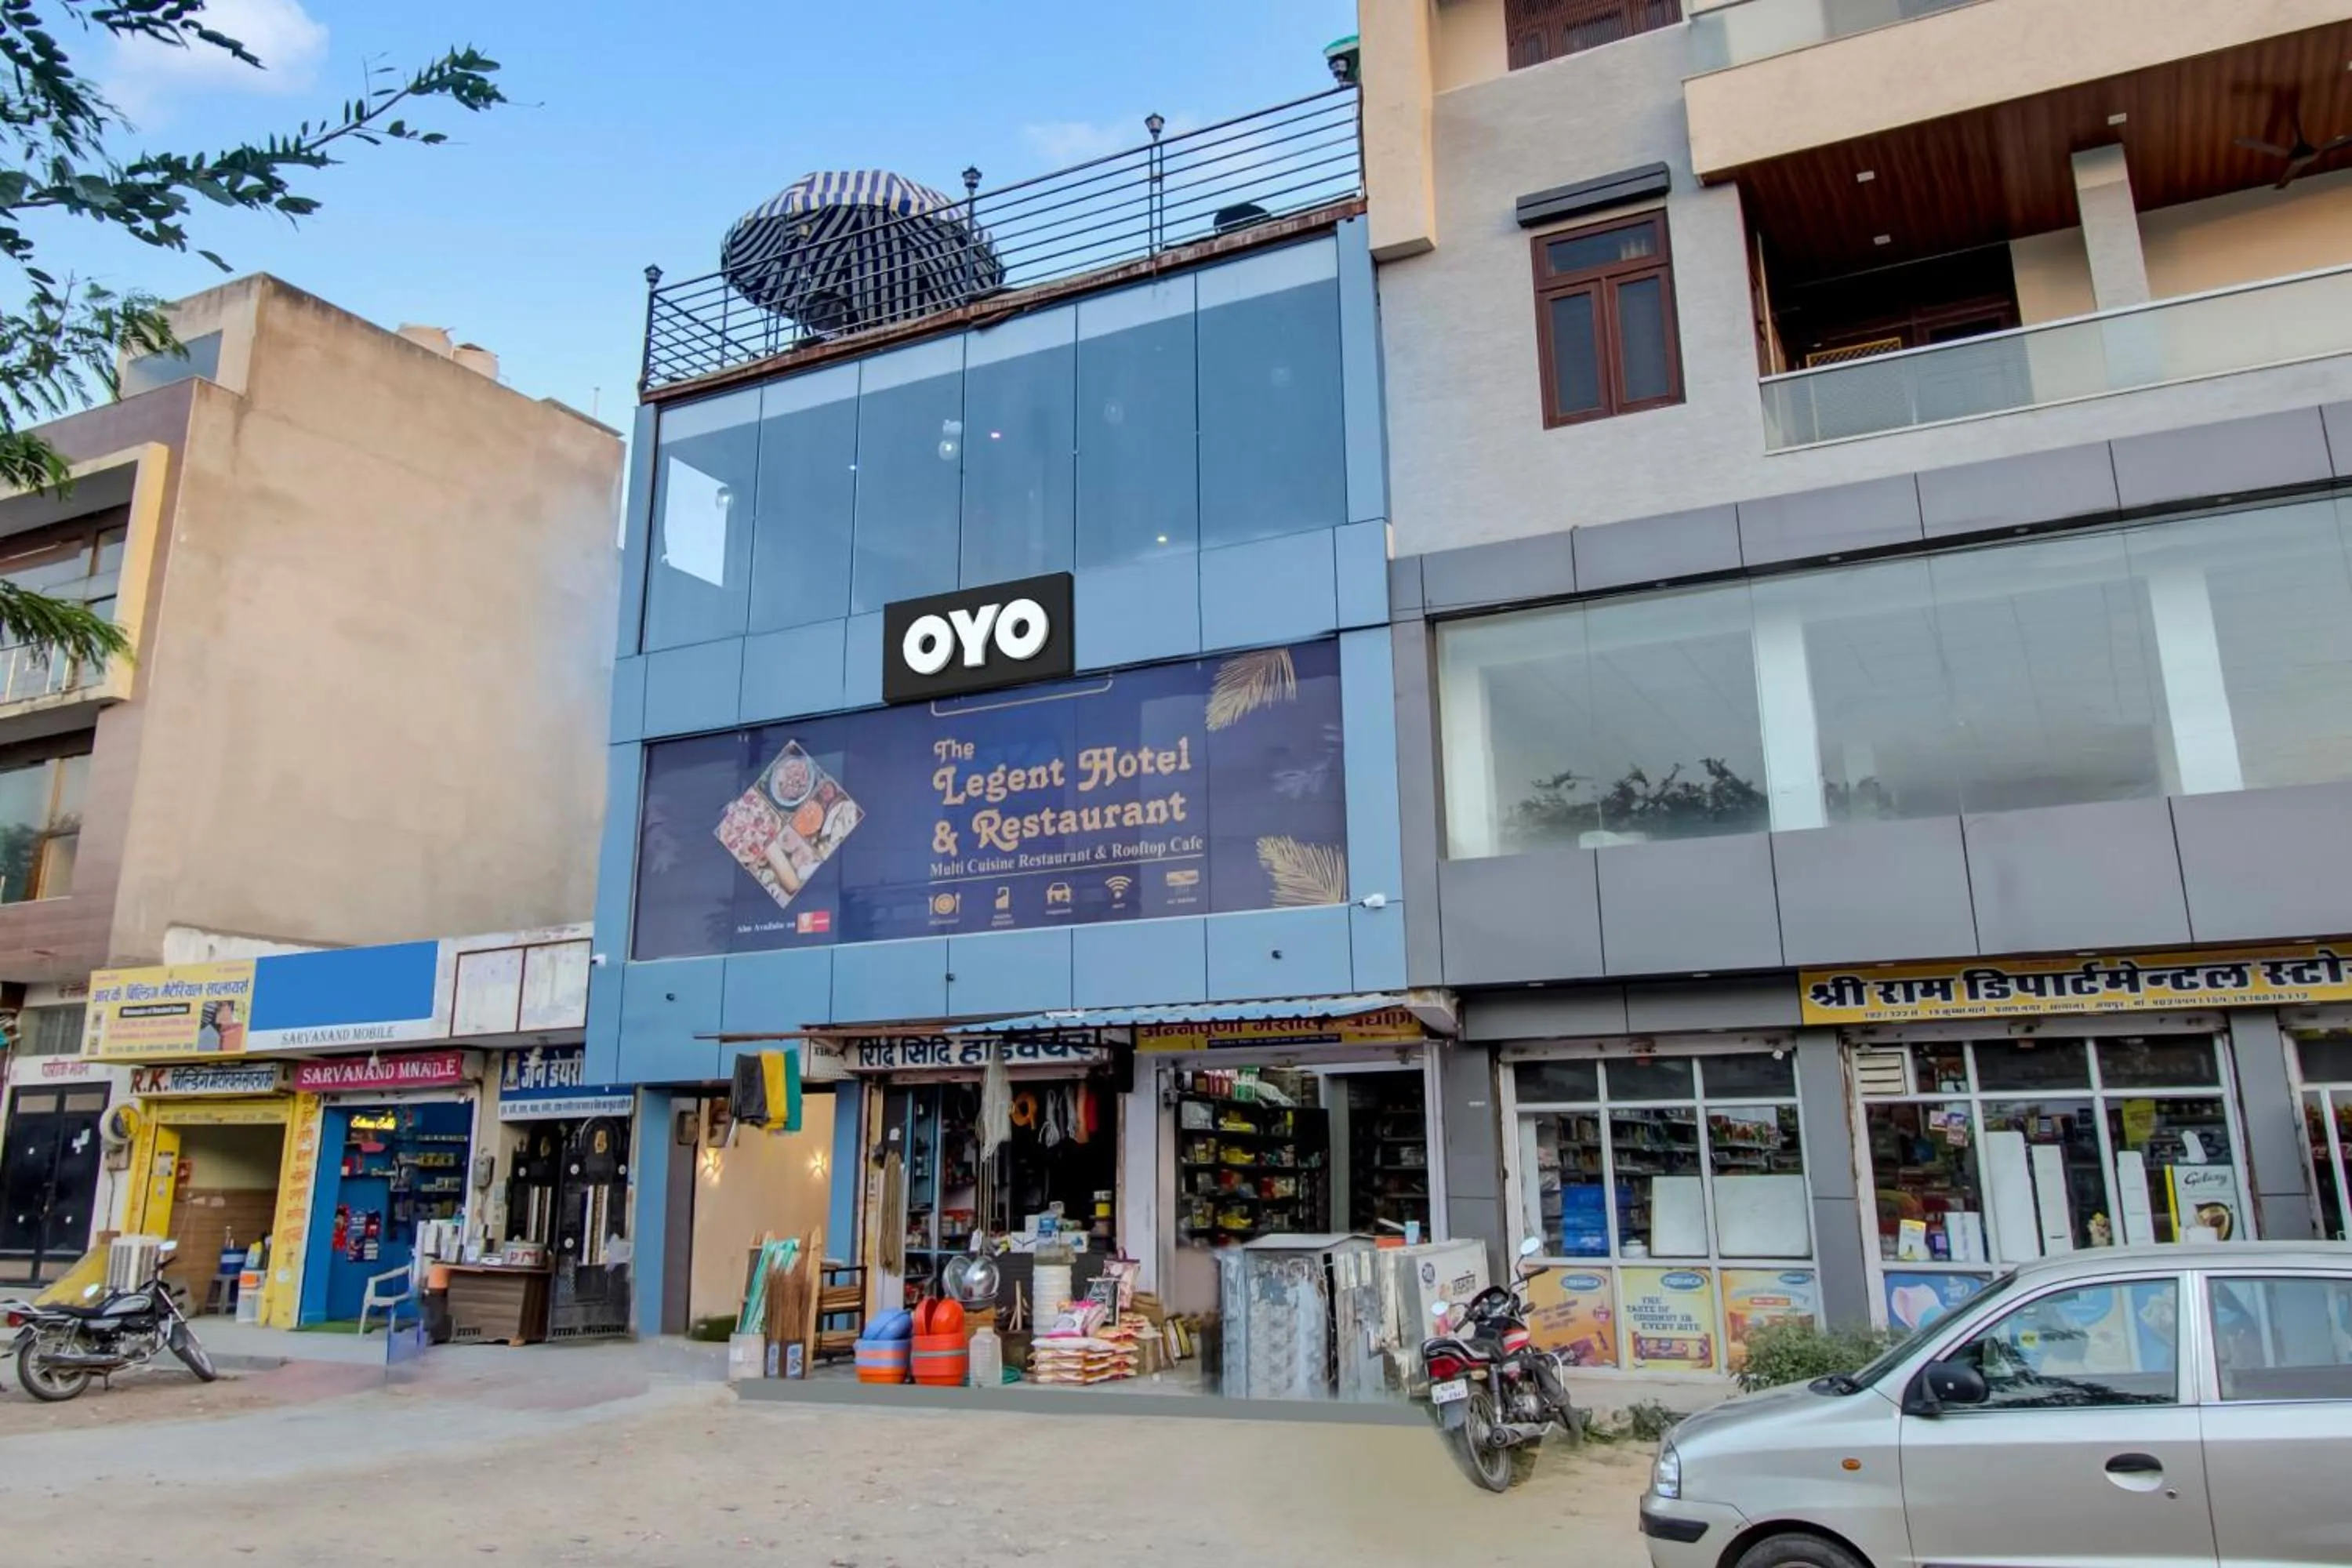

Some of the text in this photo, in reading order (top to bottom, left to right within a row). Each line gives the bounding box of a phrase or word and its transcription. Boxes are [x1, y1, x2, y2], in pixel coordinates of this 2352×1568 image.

[902, 598, 1049, 675] OYO
[932, 735, 1192, 805] Legent Hotel
[933, 739, 975, 761] The
[932, 791, 1187, 857] & Restaurant
[930, 834, 1203, 878] Multi Cuisine Restaurant & Rooftop Cafe
[1809, 975, 1867, 1007] श्री
[1874, 978, 1955, 1004] राम
[2260, 949, 2352, 985] स्टो
[354, 1025, 394, 1040] MOBILE
[301, 1062, 395, 1084] SARVANAND
[549, 1049, 585, 1087] डेयरी
